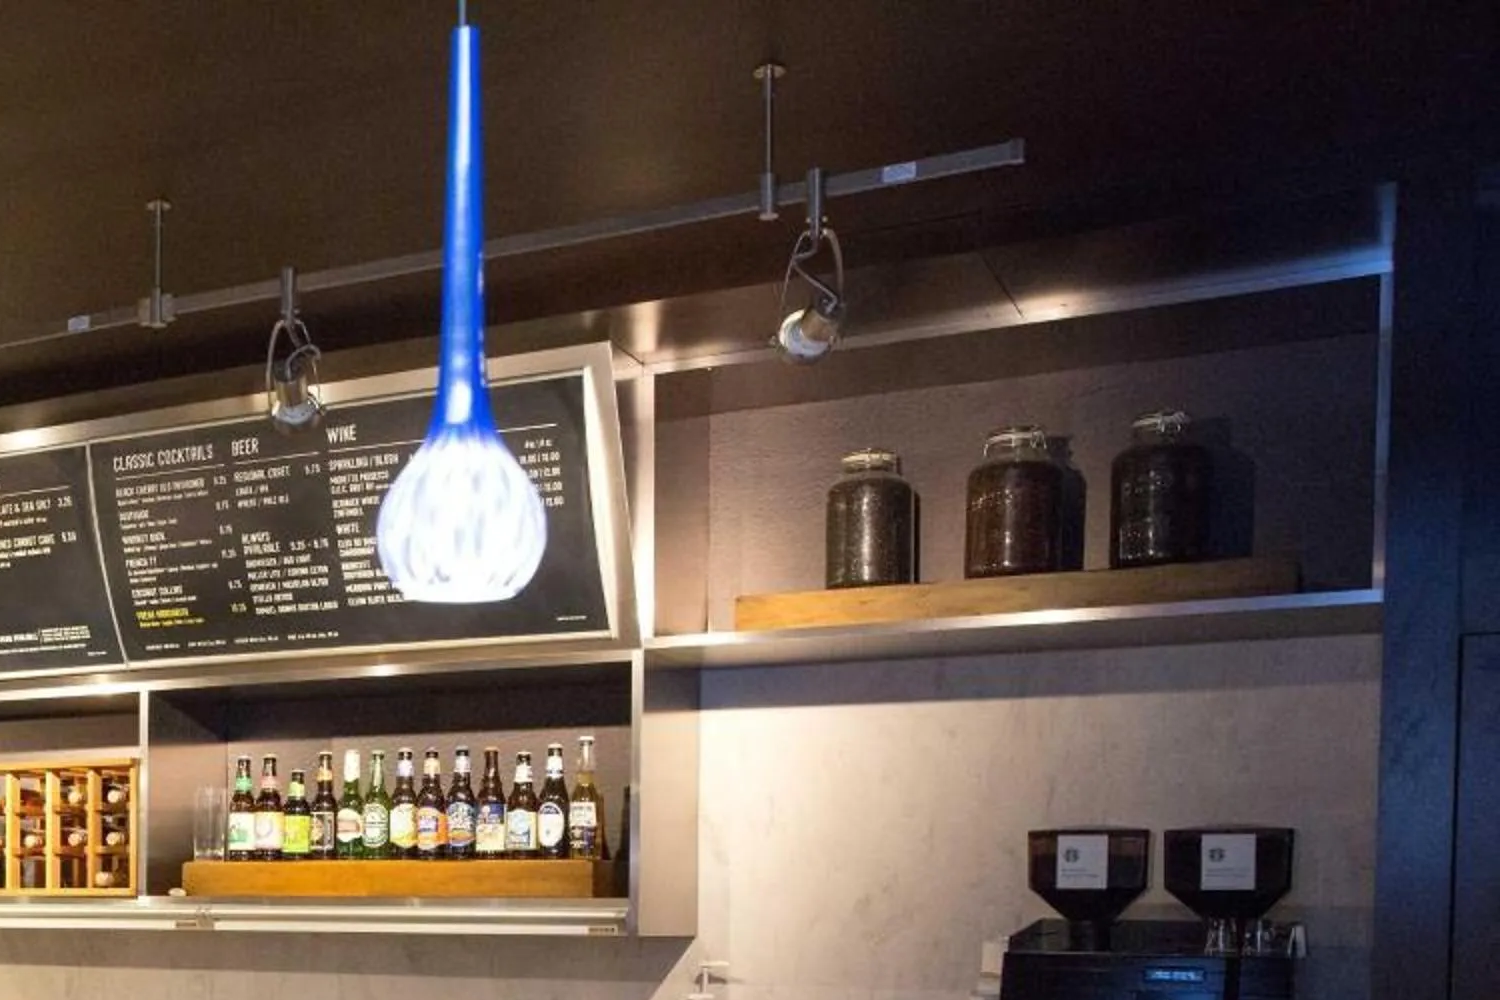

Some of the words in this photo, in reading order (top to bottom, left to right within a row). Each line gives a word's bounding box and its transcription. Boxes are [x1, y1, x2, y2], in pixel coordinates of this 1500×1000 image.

[325, 423, 356, 444] WINE
[231, 437, 259, 456] BEER
[113, 452, 155, 472] CLASSIC
[157, 443, 213, 466] COCKTAILS
